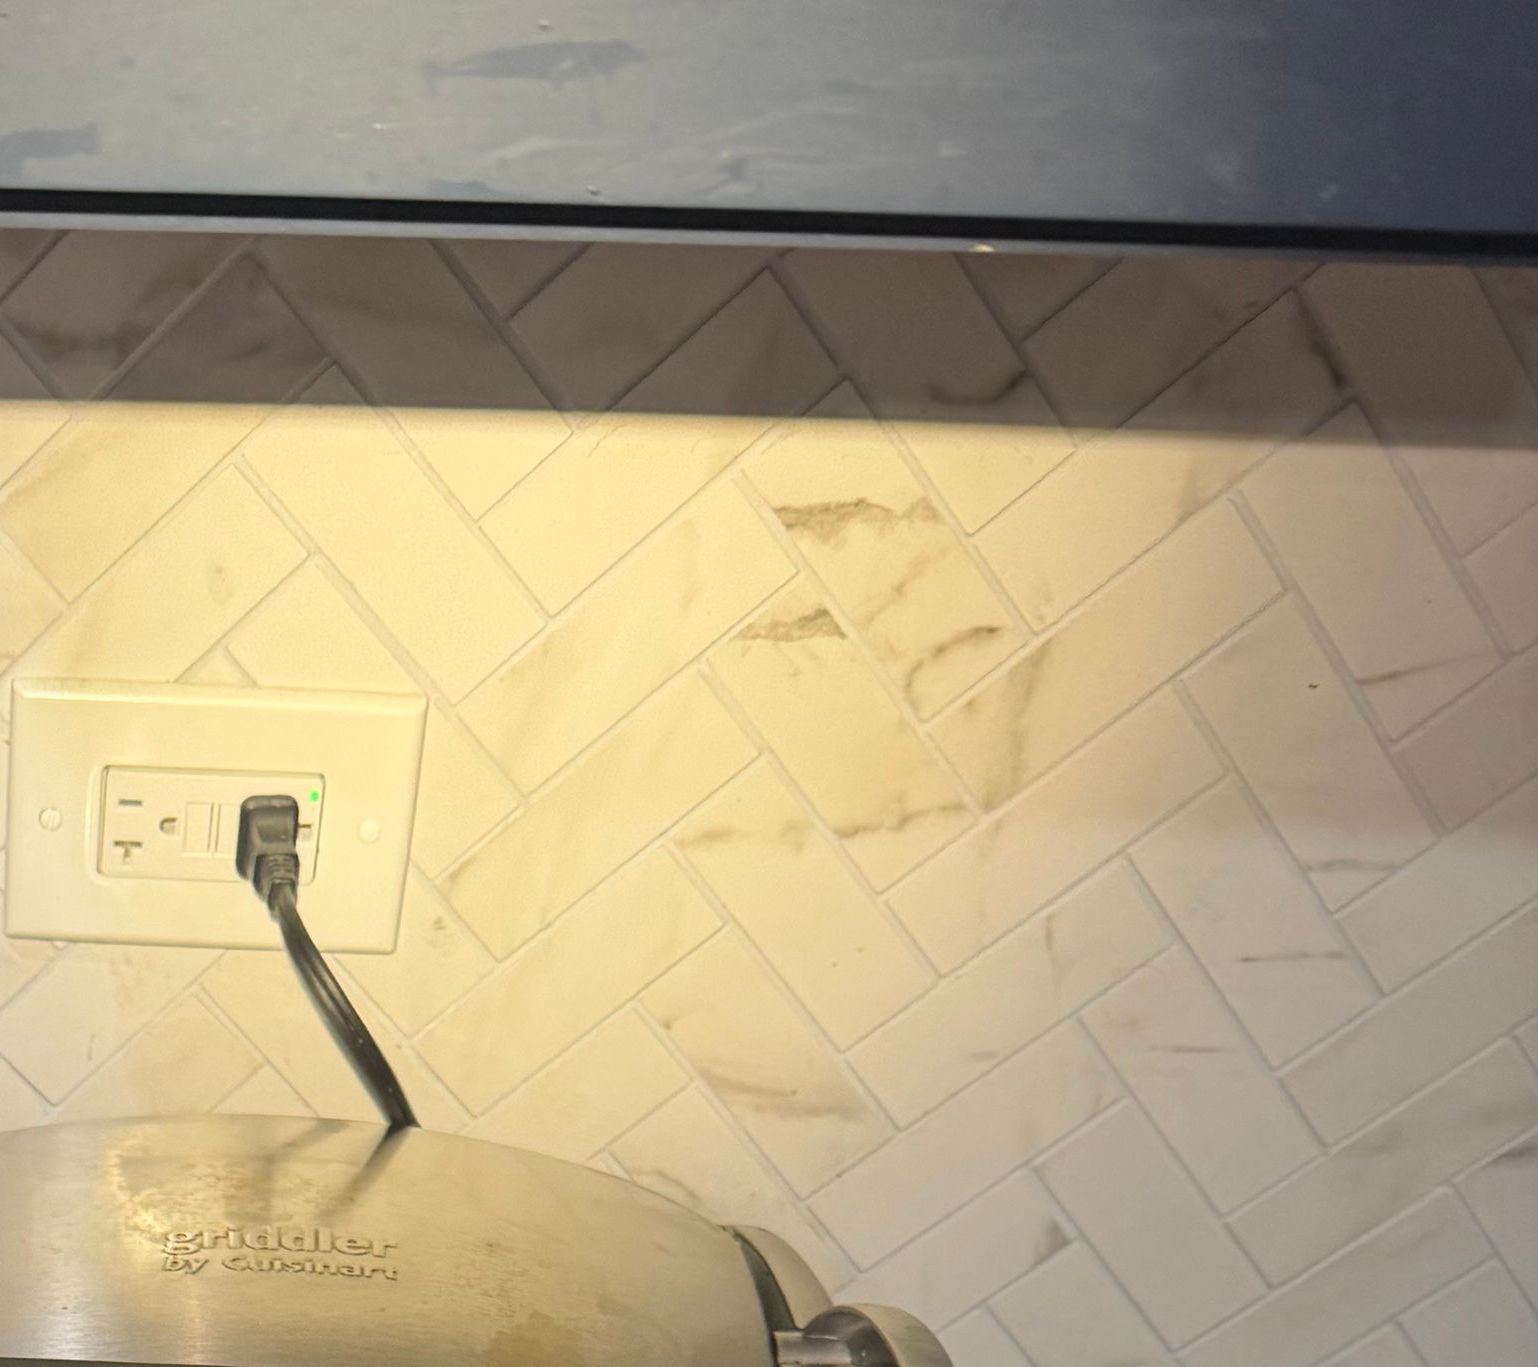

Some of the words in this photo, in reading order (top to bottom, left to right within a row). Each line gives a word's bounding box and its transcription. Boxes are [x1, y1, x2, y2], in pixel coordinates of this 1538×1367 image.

[163, 1226, 398, 1257] griddler
[162, 1255, 210, 1275] by
[222, 1256, 399, 1281] Cuisinart
